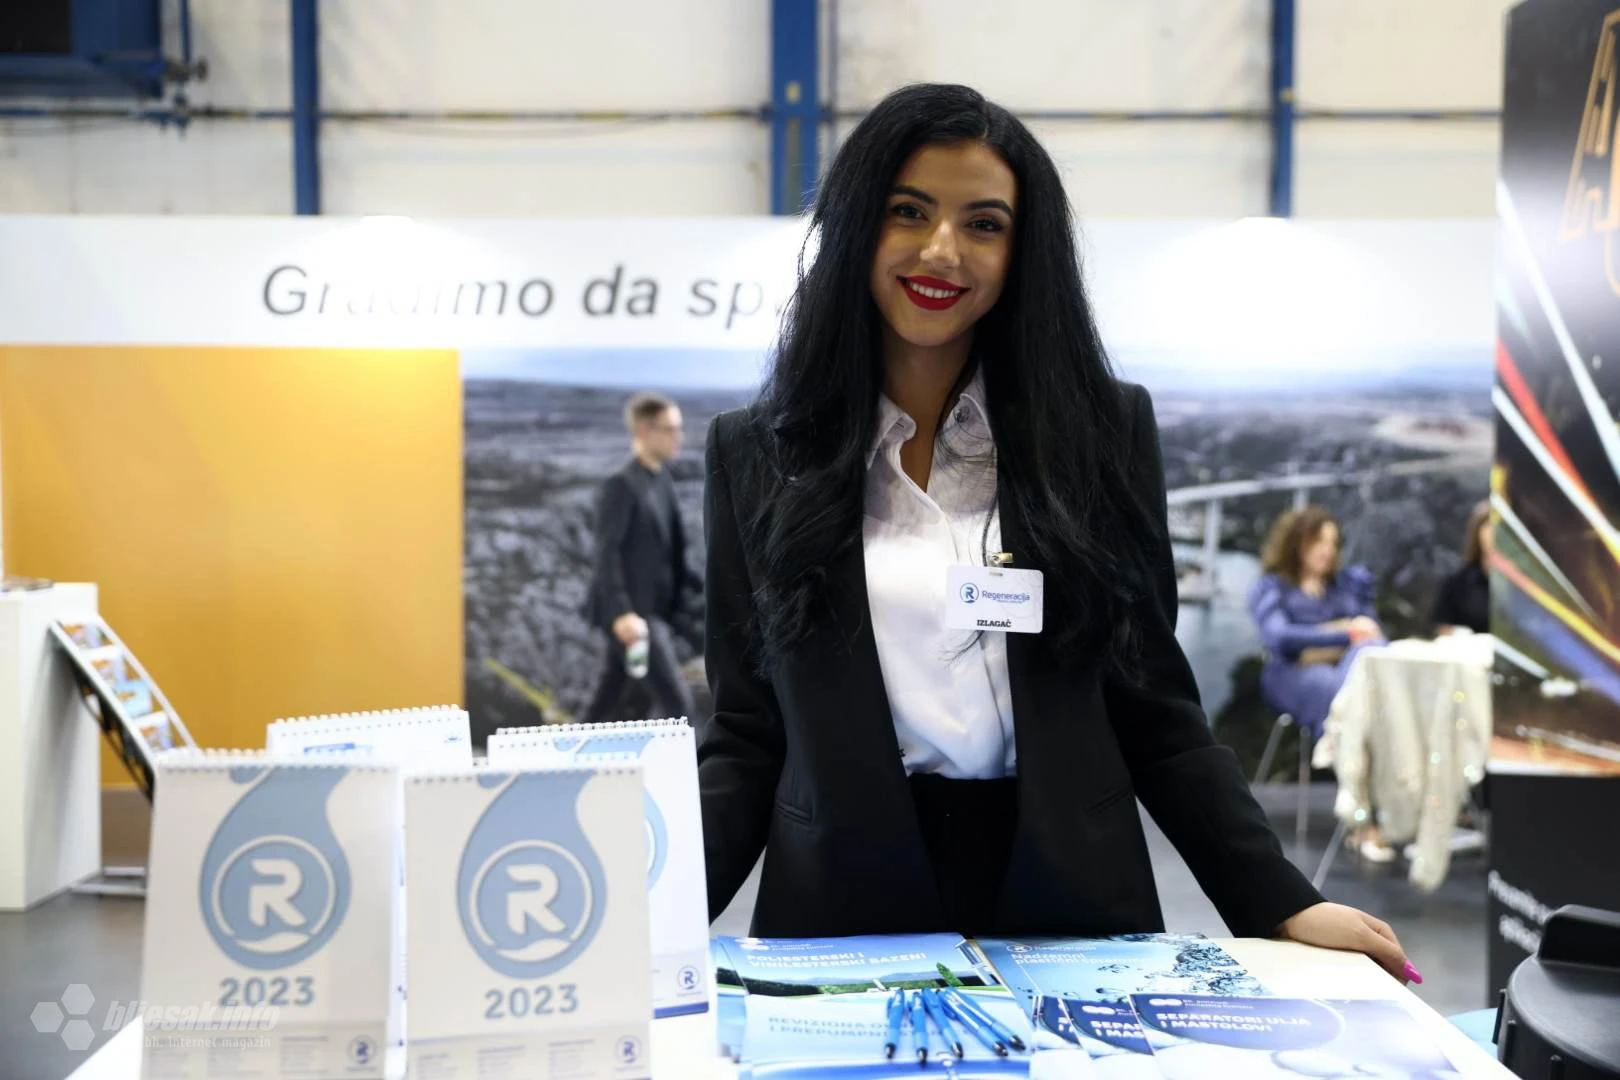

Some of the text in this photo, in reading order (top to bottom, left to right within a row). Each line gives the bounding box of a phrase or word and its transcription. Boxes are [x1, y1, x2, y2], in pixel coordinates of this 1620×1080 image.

[261, 260, 780, 330] Grimo da sp
[982, 590, 1030, 602] Regeneracija
[977, 619, 1012, 628] IZLAGAČ
[219, 976, 315, 1007] 2023
[484, 984, 579, 1019] 2023
[1156, 1013, 1263, 1024] SEPARATORI
